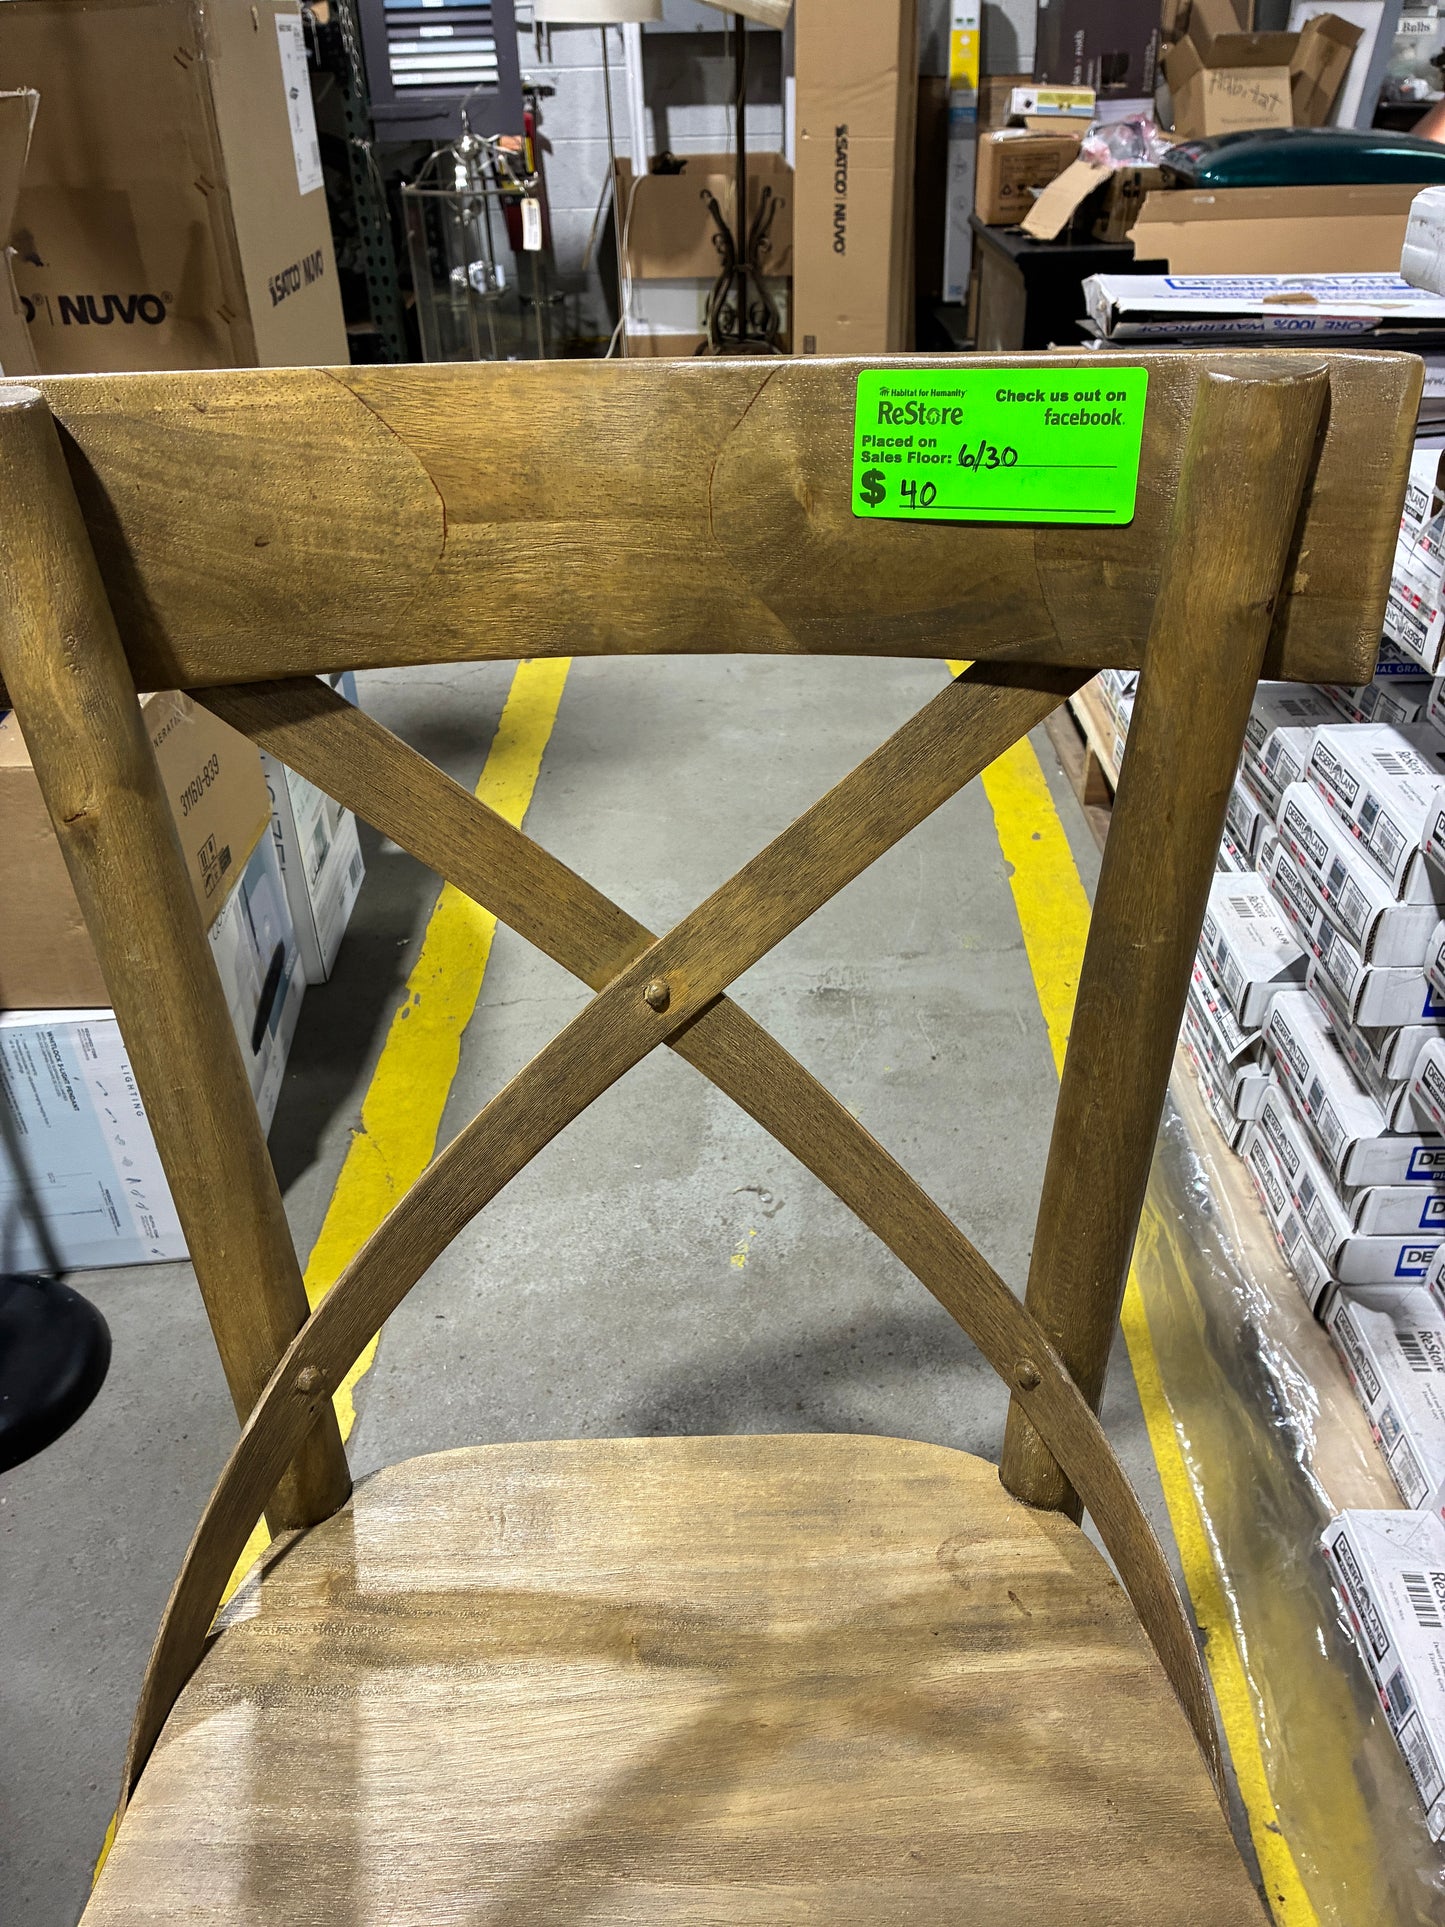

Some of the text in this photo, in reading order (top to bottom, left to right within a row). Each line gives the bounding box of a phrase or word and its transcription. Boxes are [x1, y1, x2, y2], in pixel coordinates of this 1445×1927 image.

[833, 138, 848, 254] SATCO NUVO
[275, 264, 301, 302] SATCO
[1274, 319, 1316, 332] 100%
[877, 401, 963, 426] ReStore
[891, 388, 965, 399] Habitat for Humanity
[996, 388, 1126, 402] Check us out on
[861, 440, 1018, 473] Sales Floor: 6/30
[862, 435, 937, 448] Placed on
[860, 468, 937, 510] $ 40
[180, 753, 219, 817] 31160-839
[1316, 746, 1354, 794] DESERT LAND
[1288, 805, 1324, 857] DESERT LAND
[1279, 861, 1313, 913] DESERT LAND
[1274, 1015, 1306, 1072] DESERT LAND
[120, 1064, 144, 1117] LIGHTING
[1428, 1066, 1445, 1094] DESE
[1285, 1145, 1296, 1167] LAND
[1338, 1539, 1385, 1648] DESERT LAND
